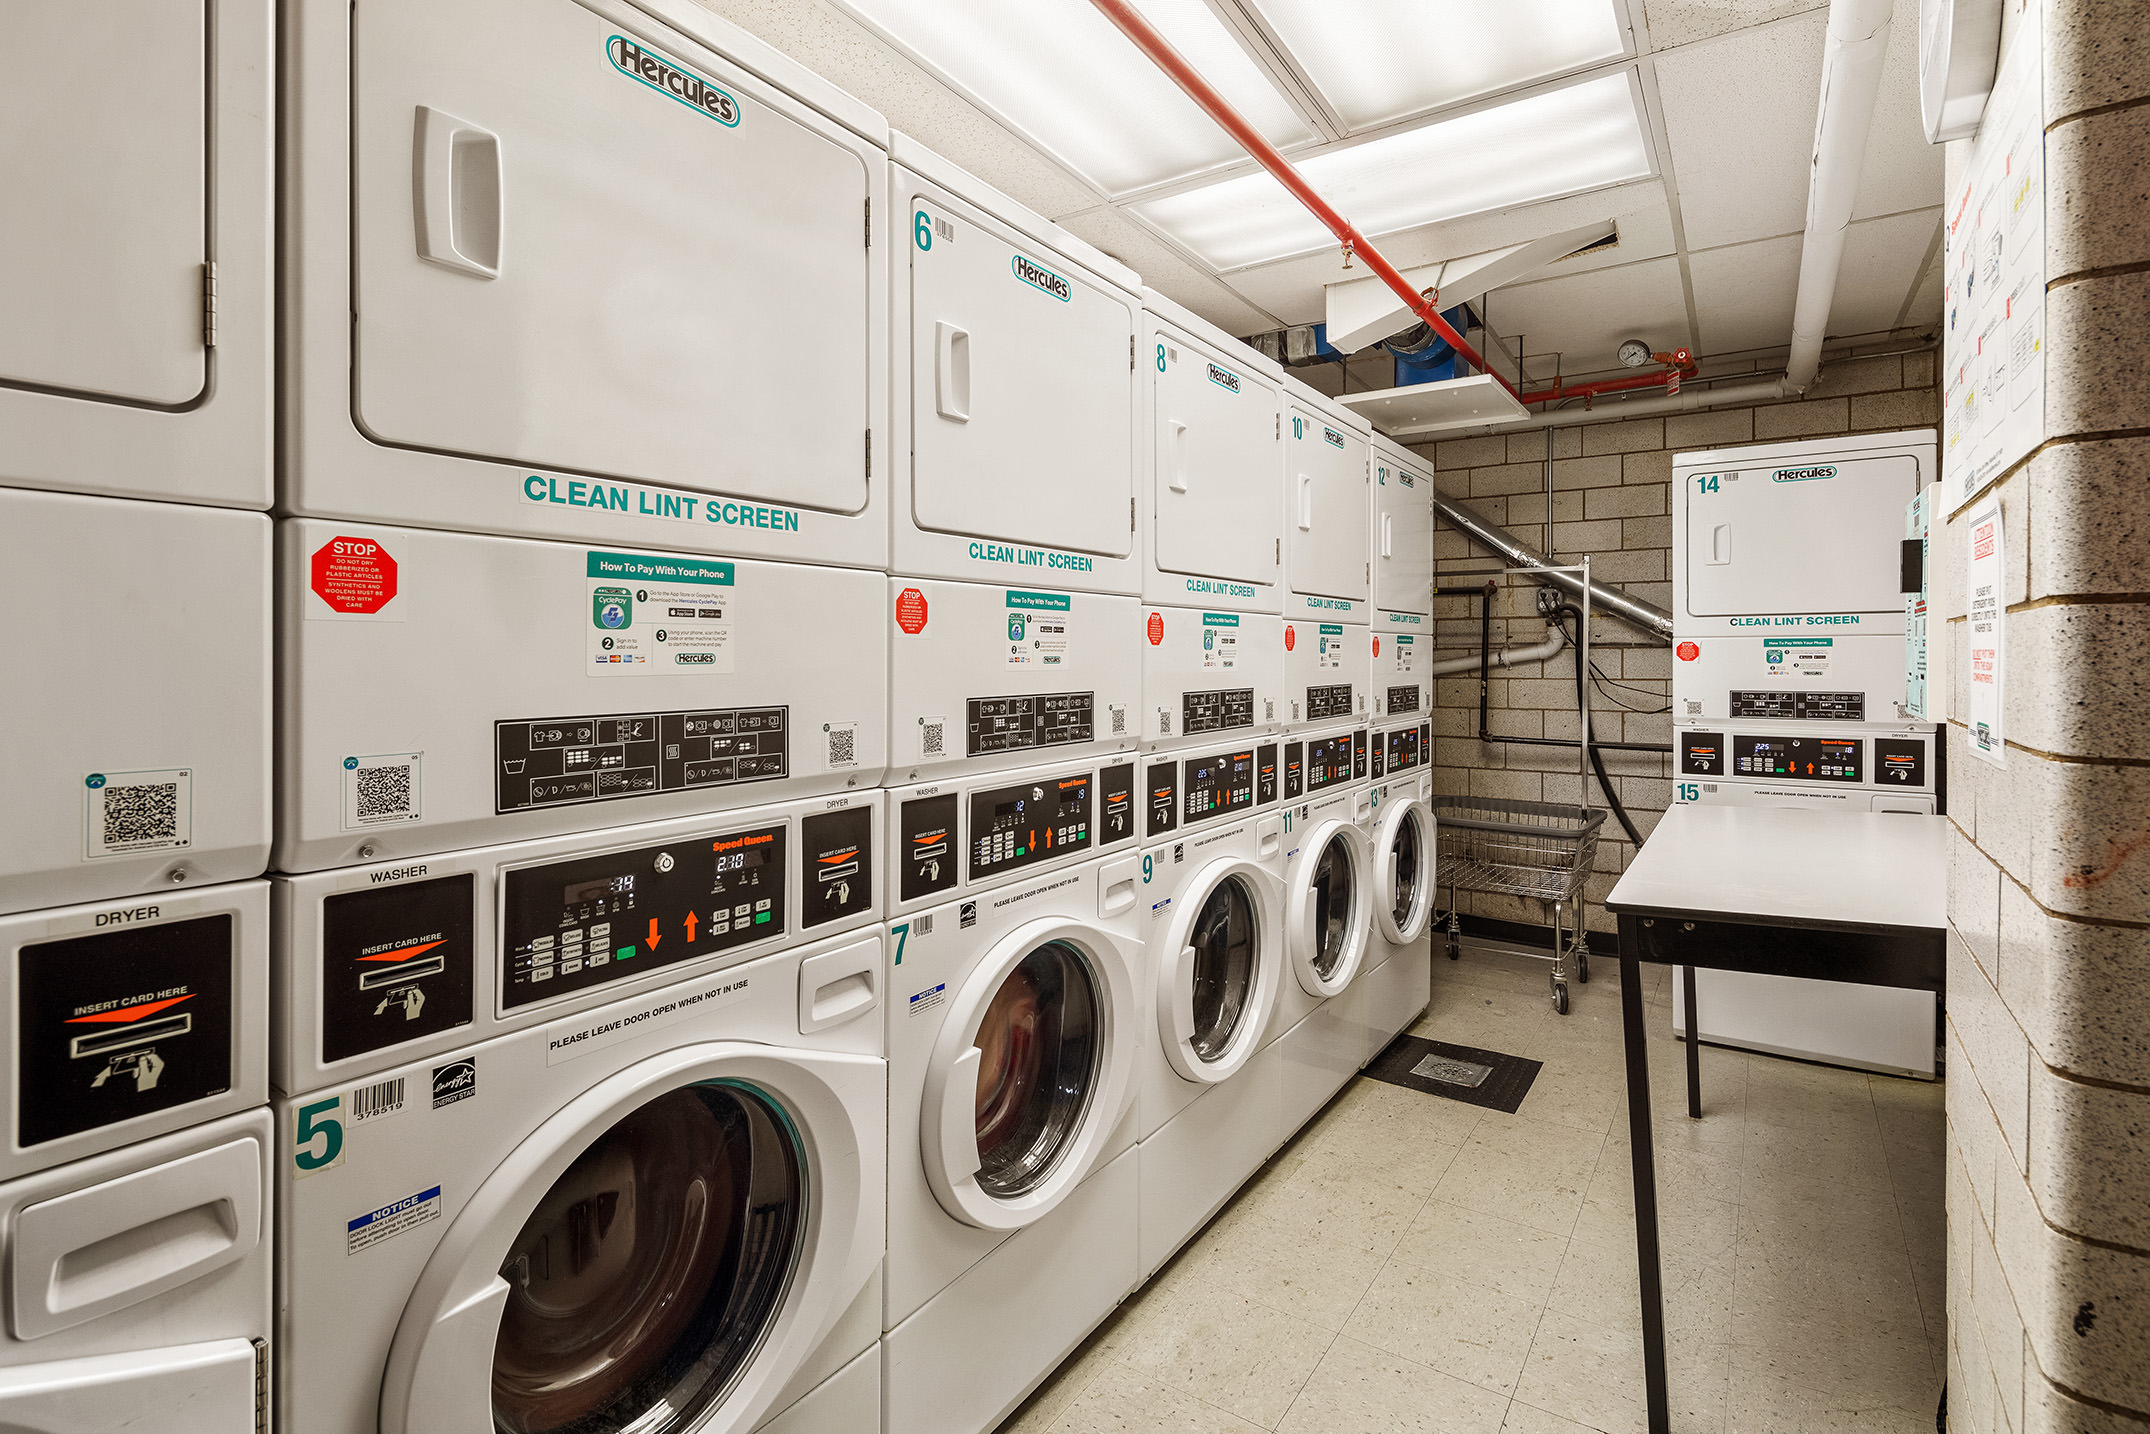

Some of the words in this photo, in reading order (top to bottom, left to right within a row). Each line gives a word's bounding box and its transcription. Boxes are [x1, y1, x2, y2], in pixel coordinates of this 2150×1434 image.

[621, 38, 732, 120] Hercules
[915, 211, 932, 252] 6
[1018, 257, 1067, 298] Hercules
[1157, 344, 1166, 372] 8
[1210, 363, 1239, 391] Hercules
[1292, 416, 1303, 440] 10
[1325, 428, 1344, 448] Hercules
[1378, 466, 1386, 486] 12
[1778, 467, 1833, 481] Hercules
[1697, 475, 1720, 494] 14
[524, 475, 629, 511] CLEAN
[639, 492, 698, 519] LINT
[706, 501, 799, 532] SCREEN
[333, 541, 377, 556] STOP
[969, 542, 1014, 563] CLEAN
[1018, 549, 1045, 567] LINT
[1048, 553, 1093, 572] SCREEN
[353, 572, 383, 580] ARTICLES
[600, 561, 623, 572] How
[624, 563, 636, 573] To
[637, 564, 654, 576] Pay
[655, 565, 677, 576] With
[677, 566, 698, 577] Your
[699, 568, 725, 579] Phone
[903, 591, 920, 599] STOP
[1186, 579, 1211, 593] CLEAN
[1212, 582, 1228, 595] LINT
[1229, 584, 1256, 598] SCREEN
[598, 596, 627, 605] CyclePay
[1027, 598, 1035, 606] Pay
[1307, 597, 1323, 608] CLEAN
[1323, 600, 1334, 609] LINT
[1334, 601, 1352, 611] SCREEN
[1730, 617, 1770, 626] CLEAN
[1774, 616, 1802, 625] LINT
[1806, 615, 1860, 625] SCREEN
[604, 638, 612, 649] 2
[678, 654, 713, 662] Hercules
[916, 787, 938, 796] WASHER
[1058, 780, 1073, 789] Speed
[1677, 783, 1699, 801] 15
[826, 799, 849, 809] DRYER
[1371, 788, 1378, 808] 13
[1283, 810, 1292, 834] 11
[712, 838, 743, 852] Speed
[743, 834, 773, 846] Queen
[819, 850, 834, 858] INSERT
[370, 865, 428, 883] WASHER
[1143, 854, 1153, 884] 9
[994, 898, 1010, 908] PLEASE
[1010, 893, 1024, 903] LEAVE
[1024, 890, 1036, 898] DOOR
[95, 906, 160, 926] DRYER
[362, 942, 393, 955] INSERT
[394, 937, 419, 948] CARD
[420, 932, 442, 943] HERE
[892, 923, 909, 966] 7
[74, 1000, 119, 1016] INSERT
[121, 992, 154, 1007] CARD
[157, 986, 188, 999] HERE
[919, 987, 937, 999] NOTICE
[550, 1031, 589, 1051] PLEASE
[591, 1020, 622, 1037] LEAVE
[623, 1011, 650, 1027] DOOR
[652, 1003, 677, 1017] OPEN
[678, 994, 703, 1008] WHEN
[704, 988, 721, 1000] NOT
[723, 985, 732, 994] IN
[733, 979, 749, 991] USE
[433, 1094, 458, 1108] ENERGY
[458, 1089, 476, 1100] STAR
[357, 1102, 403, 1121] 378519
[295, 1096, 344, 1171] 5
[372, 1195, 419, 1221] NOTICE
[350, 1228, 367, 1239] DOOR
[368, 1221, 384, 1232] LOCK
[384, 1215, 401, 1224] LIGHT
[402, 1209, 415, 1217] must
[350, 1234, 367, 1245] before
[368, 1223, 396, 1237] attempting
[403, 1214, 416, 1223] open
[373, 1232, 387, 1241] push
[388, 1227, 400, 1235] door
[419, 1213, 429, 1222] pull
